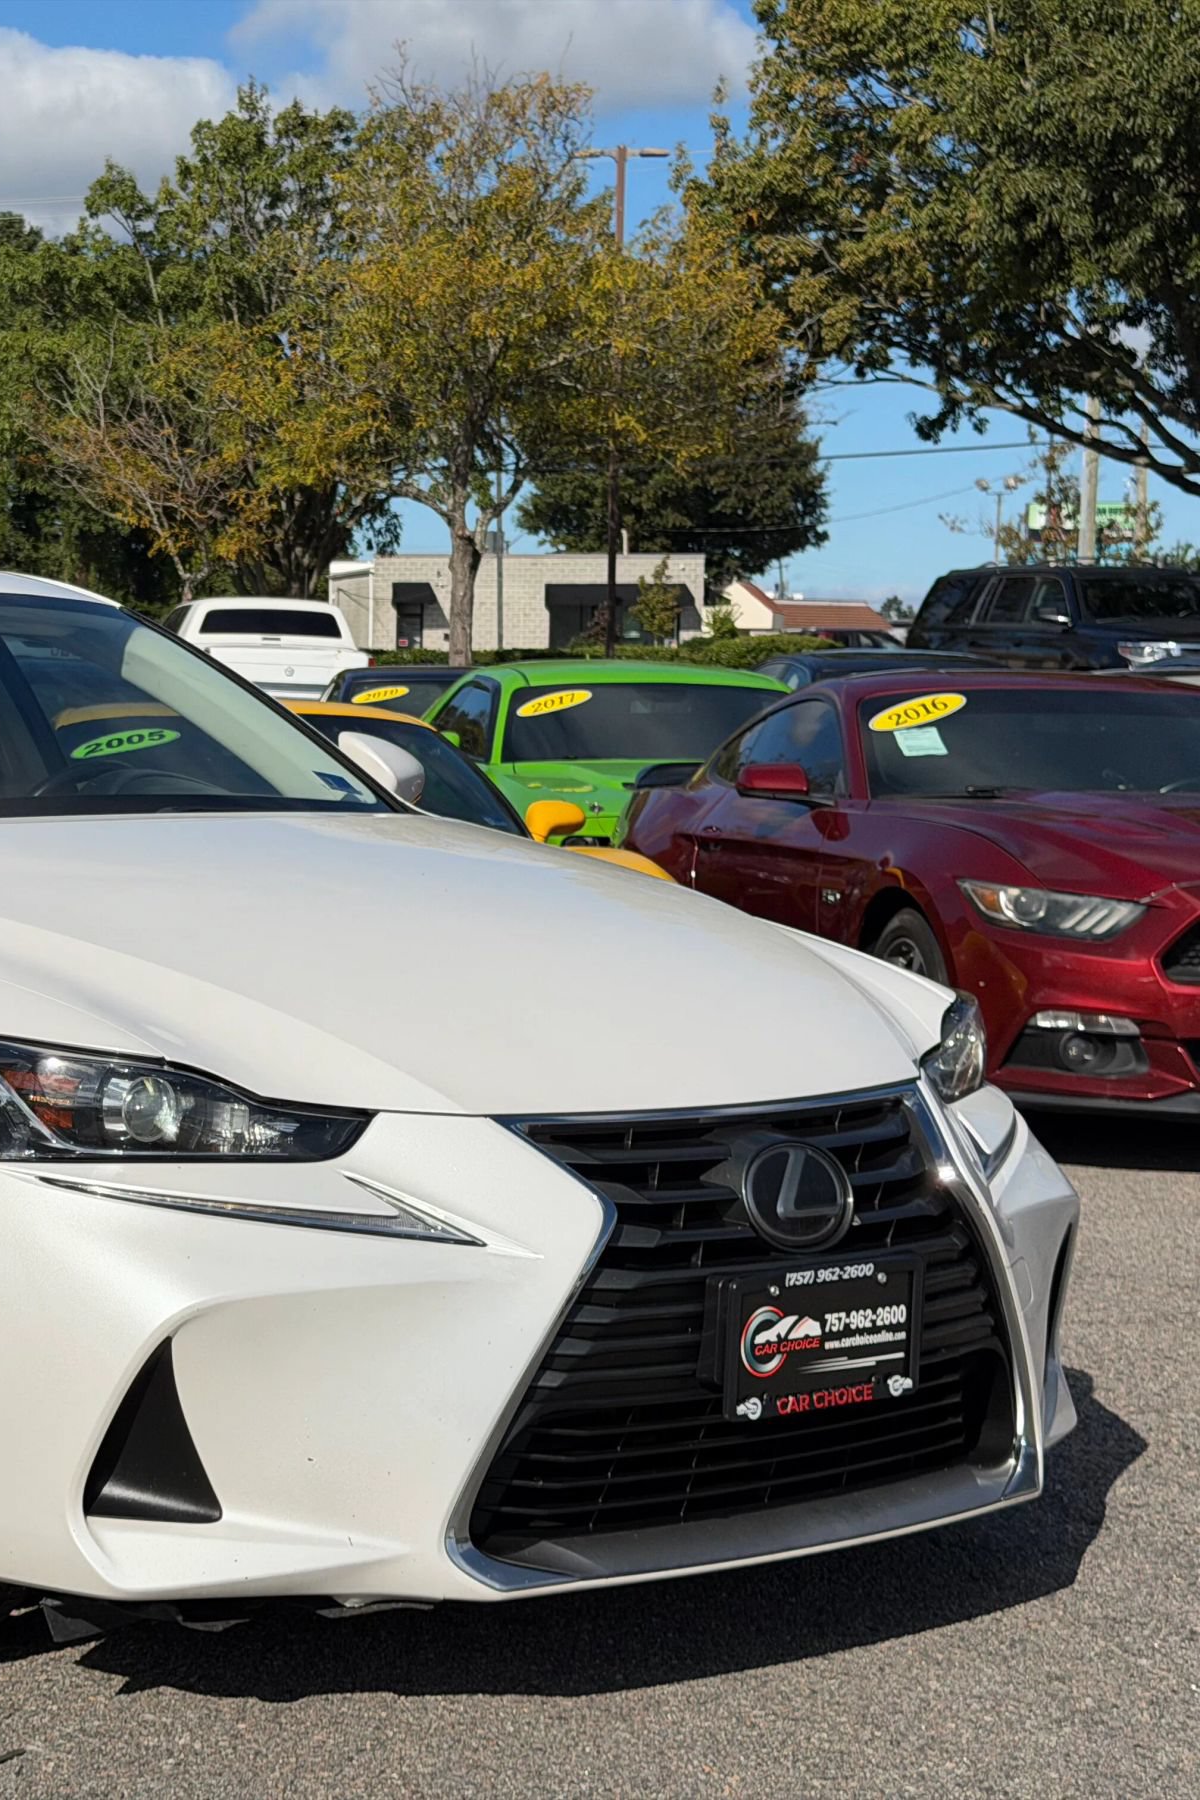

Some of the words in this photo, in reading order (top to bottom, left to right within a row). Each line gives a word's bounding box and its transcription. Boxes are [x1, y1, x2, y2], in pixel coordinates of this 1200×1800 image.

[531, 693, 575, 713] 2017
[888, 697, 948, 726] 2016
[82, 730, 166, 758] 2005
[785, 1269, 815, 1288] (757)
[816, 1262, 875, 1283] 962-2600
[824, 1303, 907, 1333] 757-962-2600
[754, 1343, 778, 1357] CAR
[780, 1337, 821, 1352] CHOICE
[776, 1395, 810, 1415] CAR
[813, 1383, 875, 1409] CHOICE
